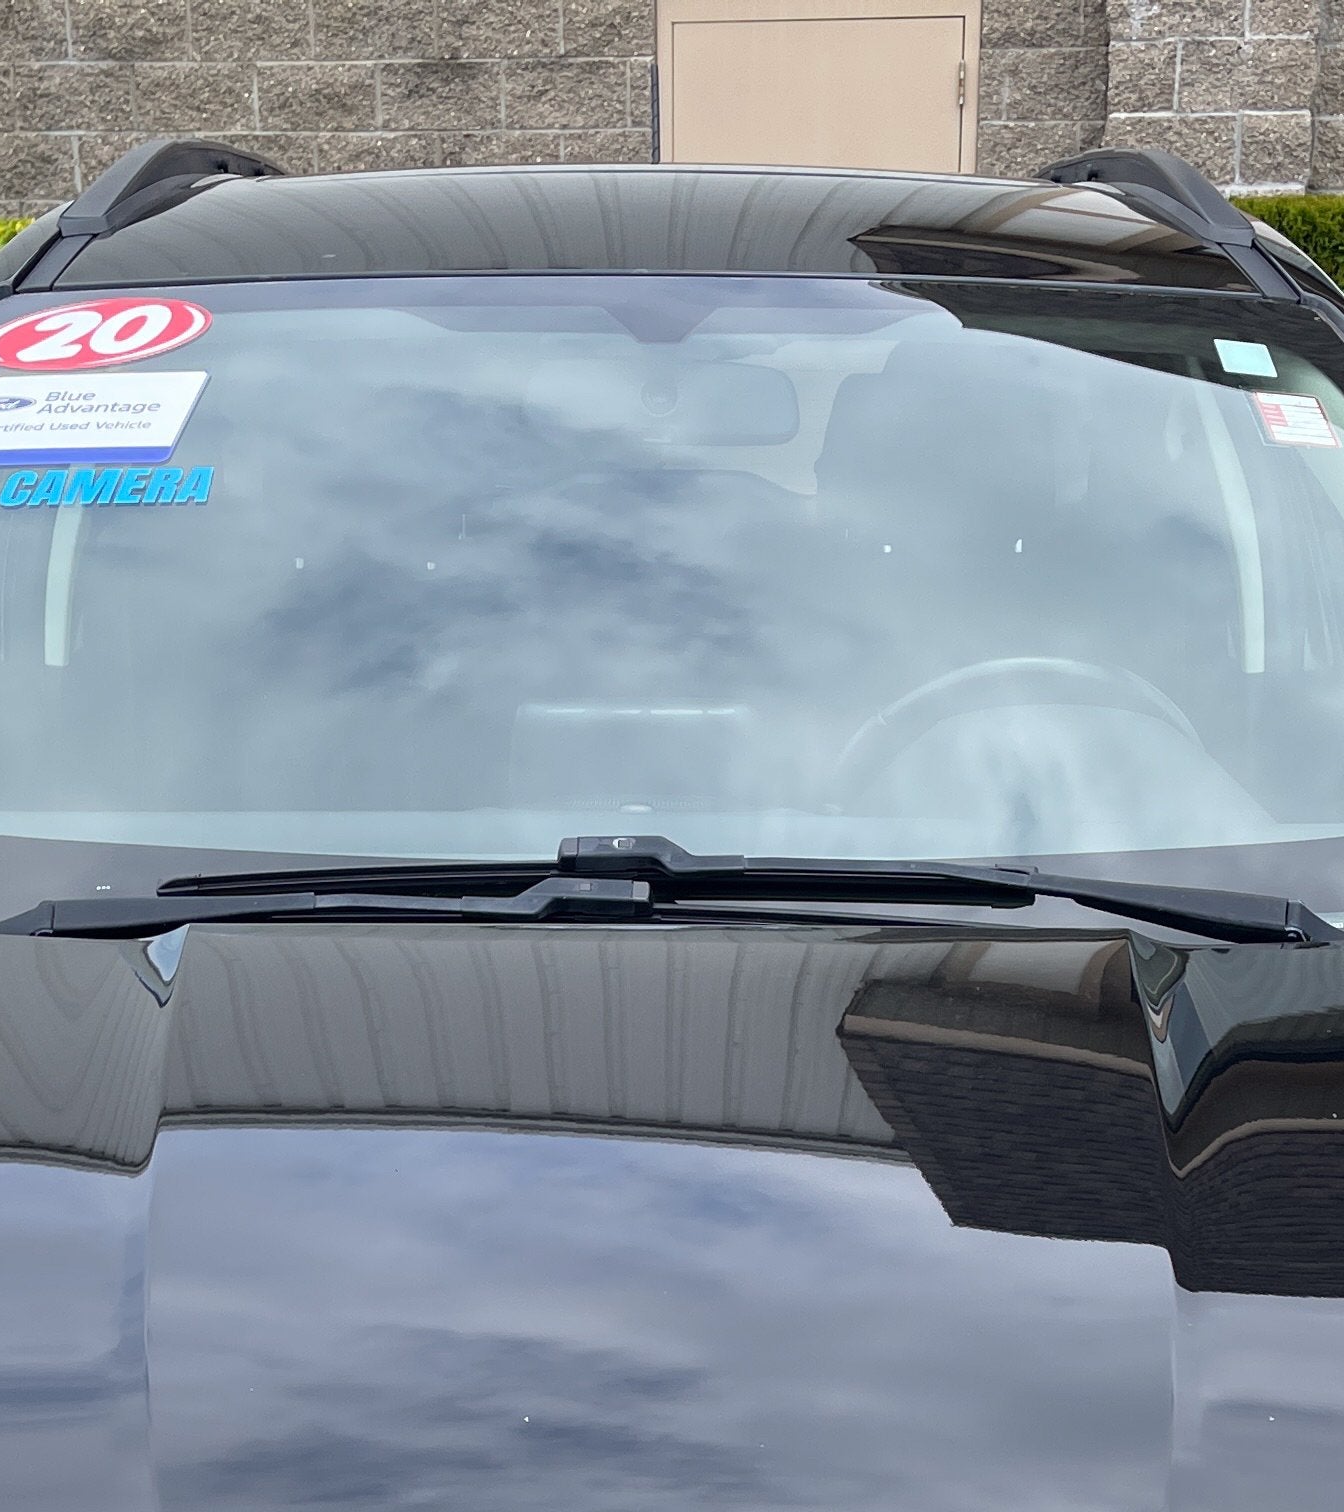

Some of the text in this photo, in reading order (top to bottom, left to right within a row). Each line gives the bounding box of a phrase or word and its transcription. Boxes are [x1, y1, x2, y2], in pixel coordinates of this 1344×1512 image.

[16, 304, 173, 363] 20
[45, 390, 96, 402] Blue
[35, 400, 161, 415] Advantage
[49, 421, 90, 432] Used
[94, 419, 152, 431] Vehicle
